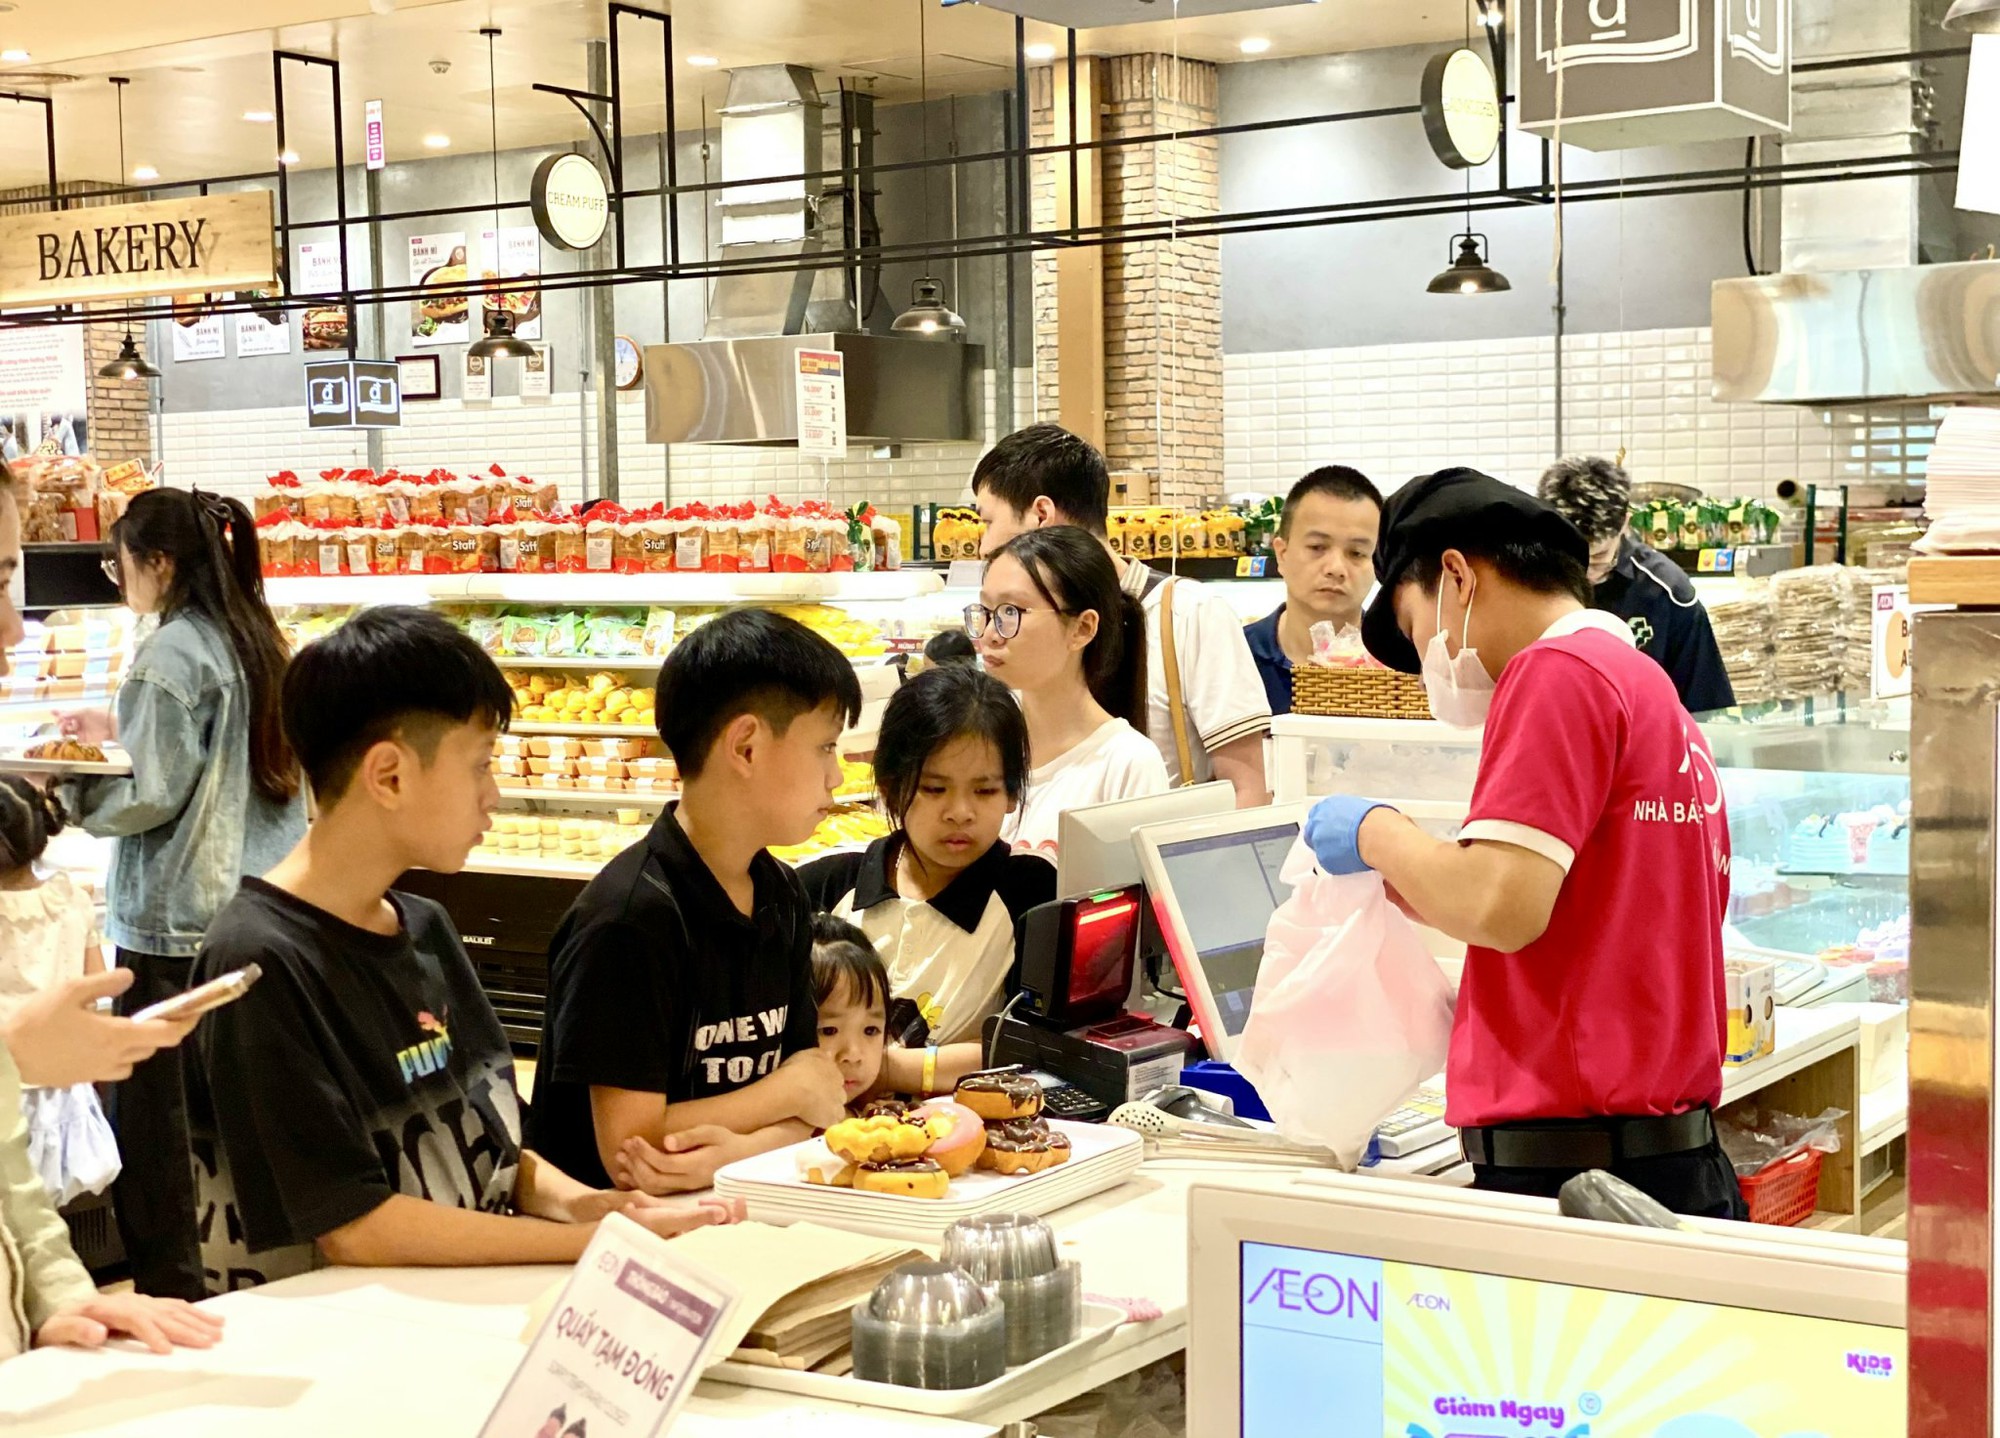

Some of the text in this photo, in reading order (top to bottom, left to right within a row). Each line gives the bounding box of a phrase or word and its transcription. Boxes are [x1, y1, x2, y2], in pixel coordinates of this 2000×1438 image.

[547, 191, 605, 211] CREAM PUFF
[36, 218, 207, 281] BAKERY
[514, 497, 533, 509] Staff
[452, 540, 476, 551] Staff
[644, 538, 666, 550] Staff
[633, 796, 669, 822] NHÀ
[694, 1015, 759, 1052] ONE
[700, 1055, 754, 1083] TO
[593, 1328, 628, 1370] TẠM
[622, 1350, 674, 1402] ĐÓNG
[1846, 1352, 1893, 1374] KIDS
[1499, 1399, 1565, 1429] Ngay
